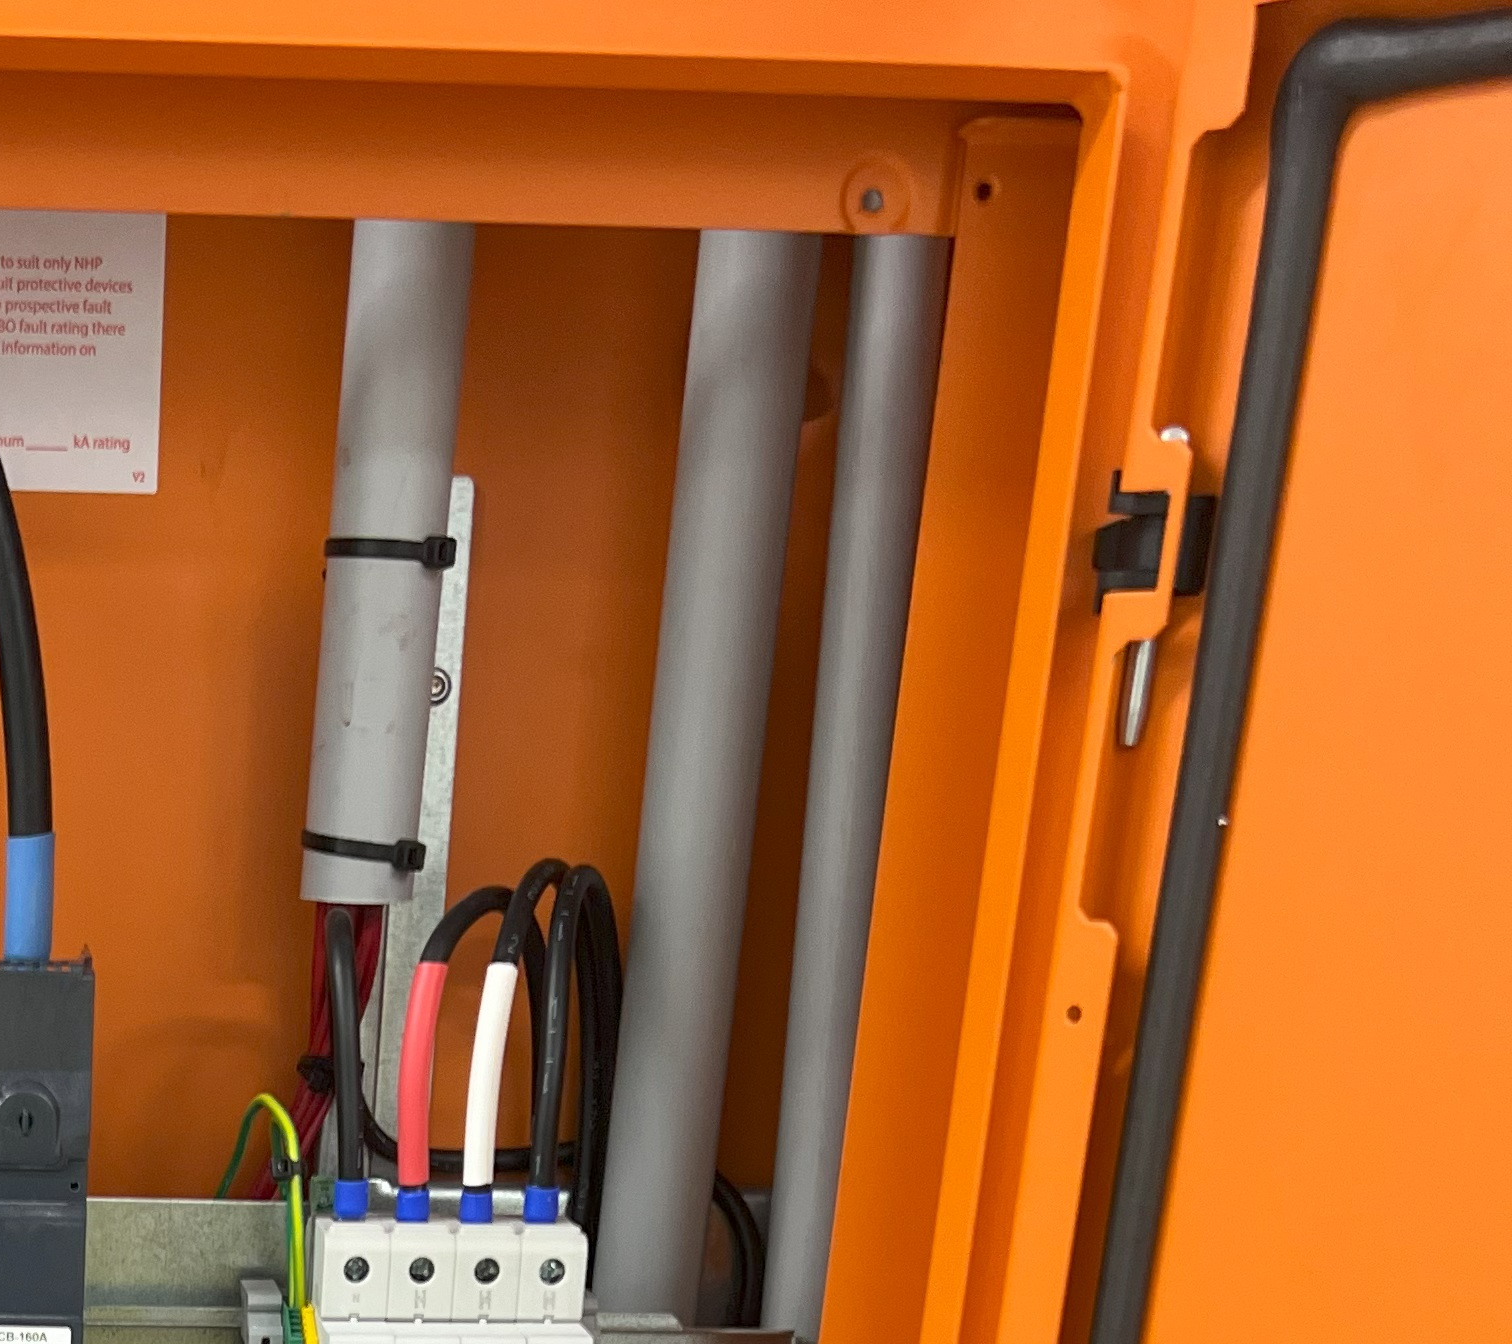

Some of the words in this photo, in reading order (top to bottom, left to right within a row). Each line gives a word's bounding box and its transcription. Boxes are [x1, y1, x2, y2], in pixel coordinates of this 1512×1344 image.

[0, 255, 15, 269] to
[17, 254, 40, 270] suit
[43, 255, 72, 273] only
[74, 256, 103, 270] NHP
[17, 277, 81, 294] protective
[85, 279, 133, 294] devices
[5, 299, 80, 315] prospective
[83, 299, 112, 314] fault
[19, 317, 47, 333] fault
[51, 319, 88, 337] rating
[92, 320, 126, 336] there
[2, 340, 76, 356] information
[79, 343, 96, 356] on
[73, 435, 89, 449] kA
[93, 435, 130, 453] rating
[132, 471, 145, 483] V2
